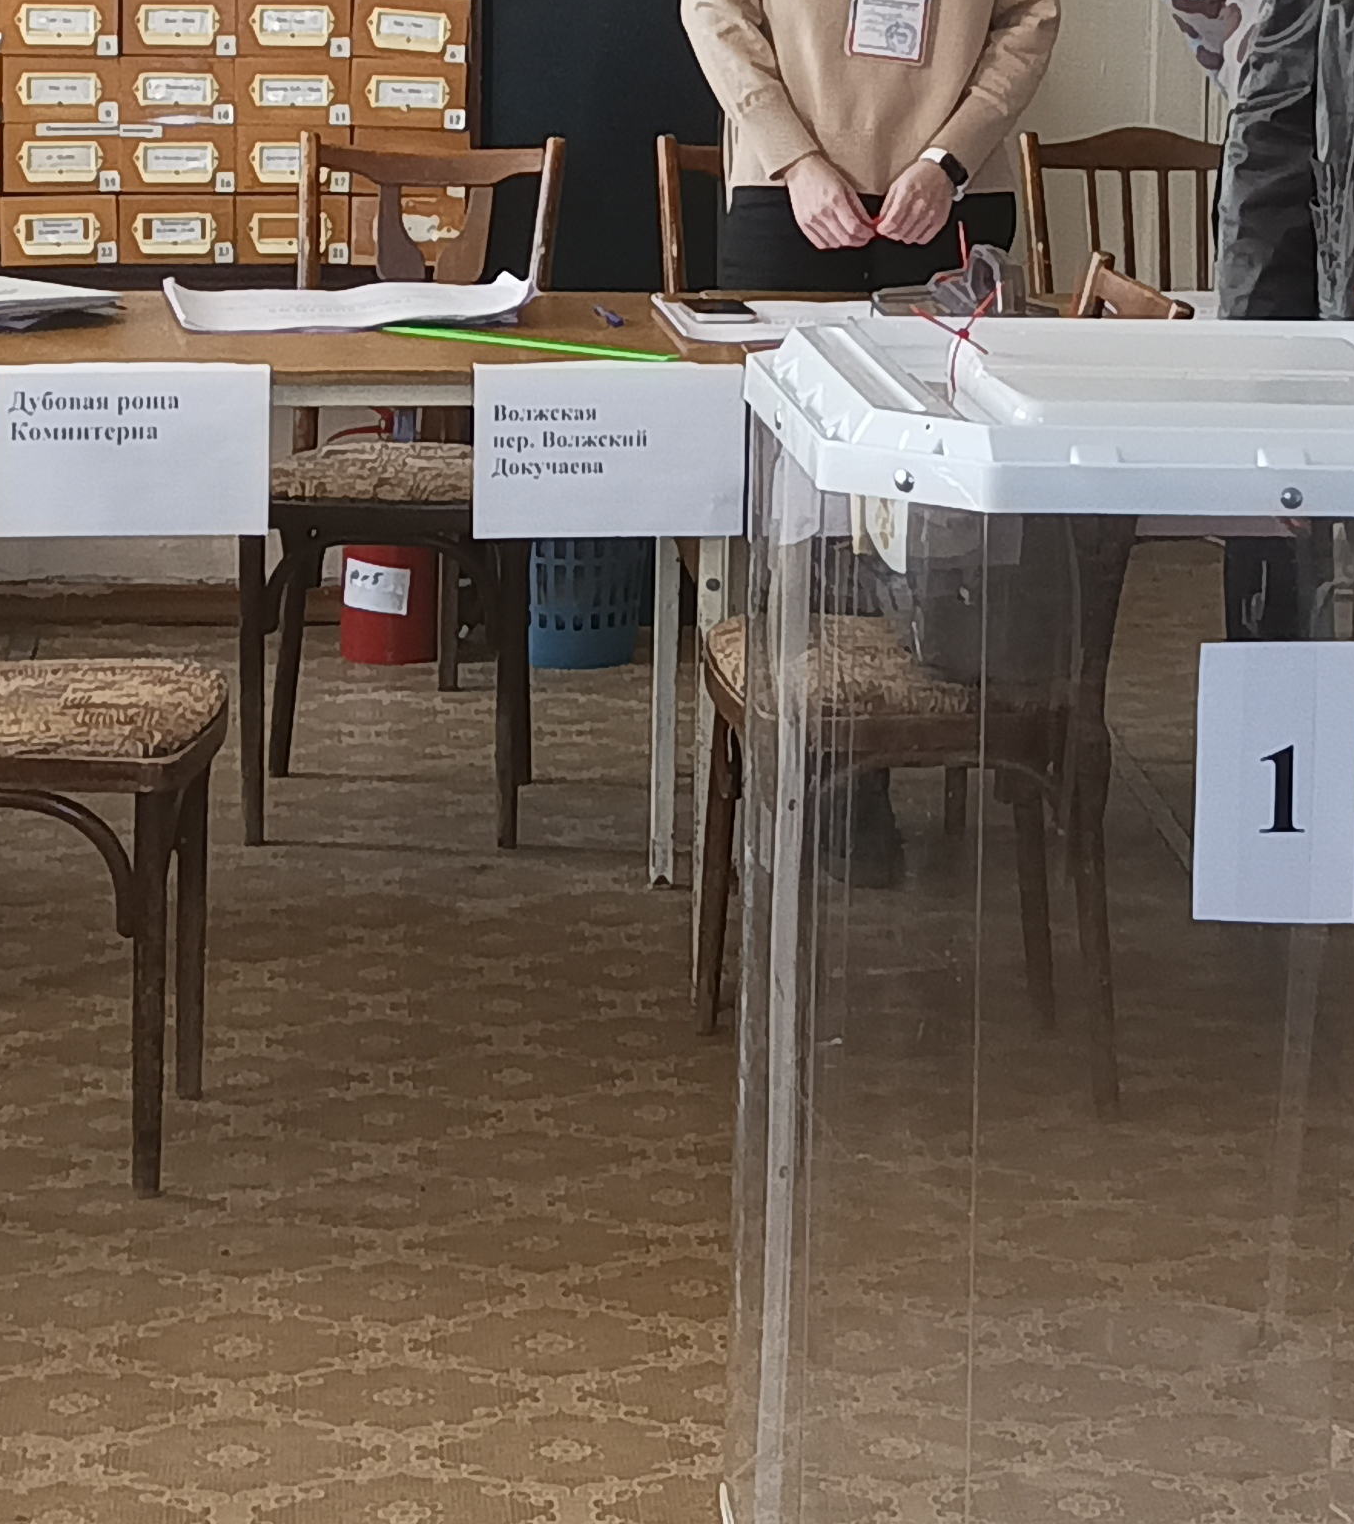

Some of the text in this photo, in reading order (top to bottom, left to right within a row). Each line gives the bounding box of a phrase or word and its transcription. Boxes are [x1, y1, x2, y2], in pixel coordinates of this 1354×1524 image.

[8, 391, 179, 416] Дубовая роща
[494, 404, 597, 422] Волжская
[11, 422, 158, 445] Коминтерна
[493, 429, 647, 453] пер. Волжский
[491, 457, 604, 479] Докучаева
[1259, 744, 1306, 834] 1
